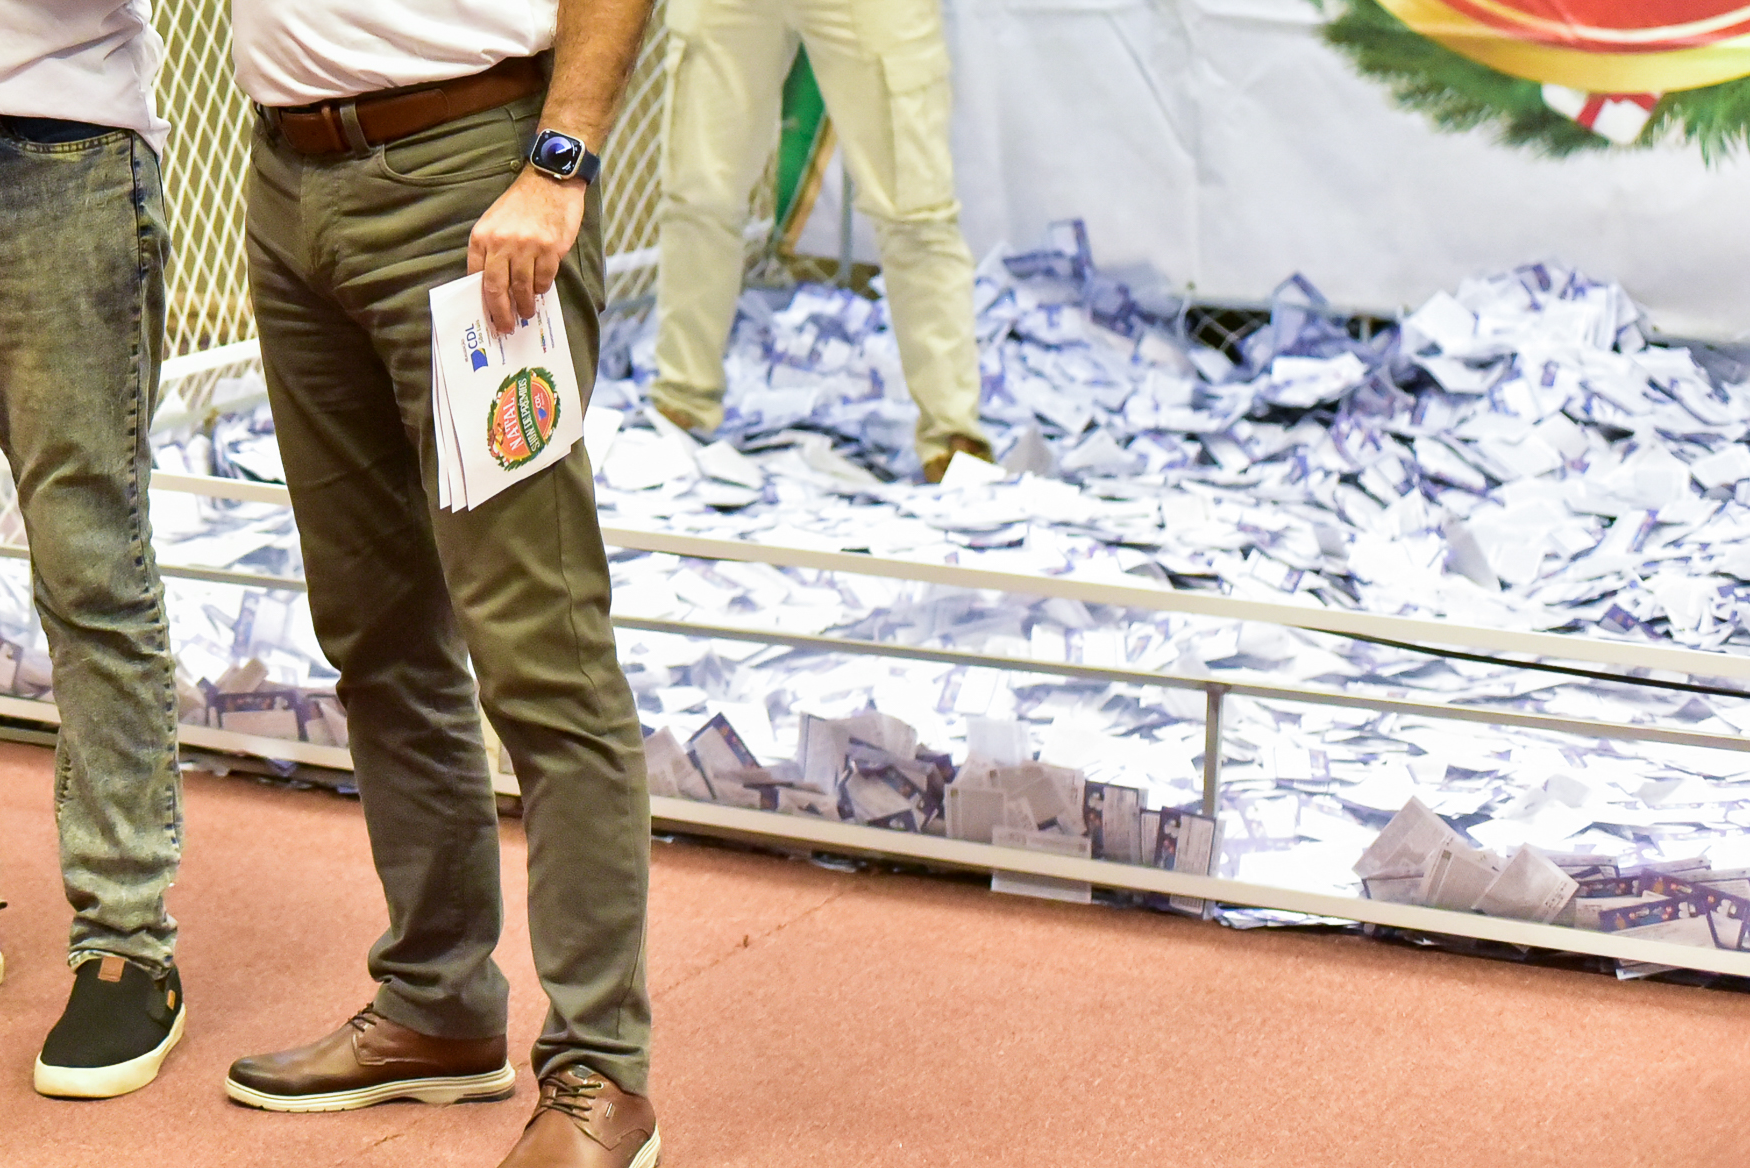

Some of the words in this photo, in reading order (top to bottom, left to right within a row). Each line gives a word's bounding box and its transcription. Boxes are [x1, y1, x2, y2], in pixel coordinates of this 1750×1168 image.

[465, 323, 478, 349] CDL
[534, 393, 542, 409] CDL
[503, 397, 524, 451] NATAL
